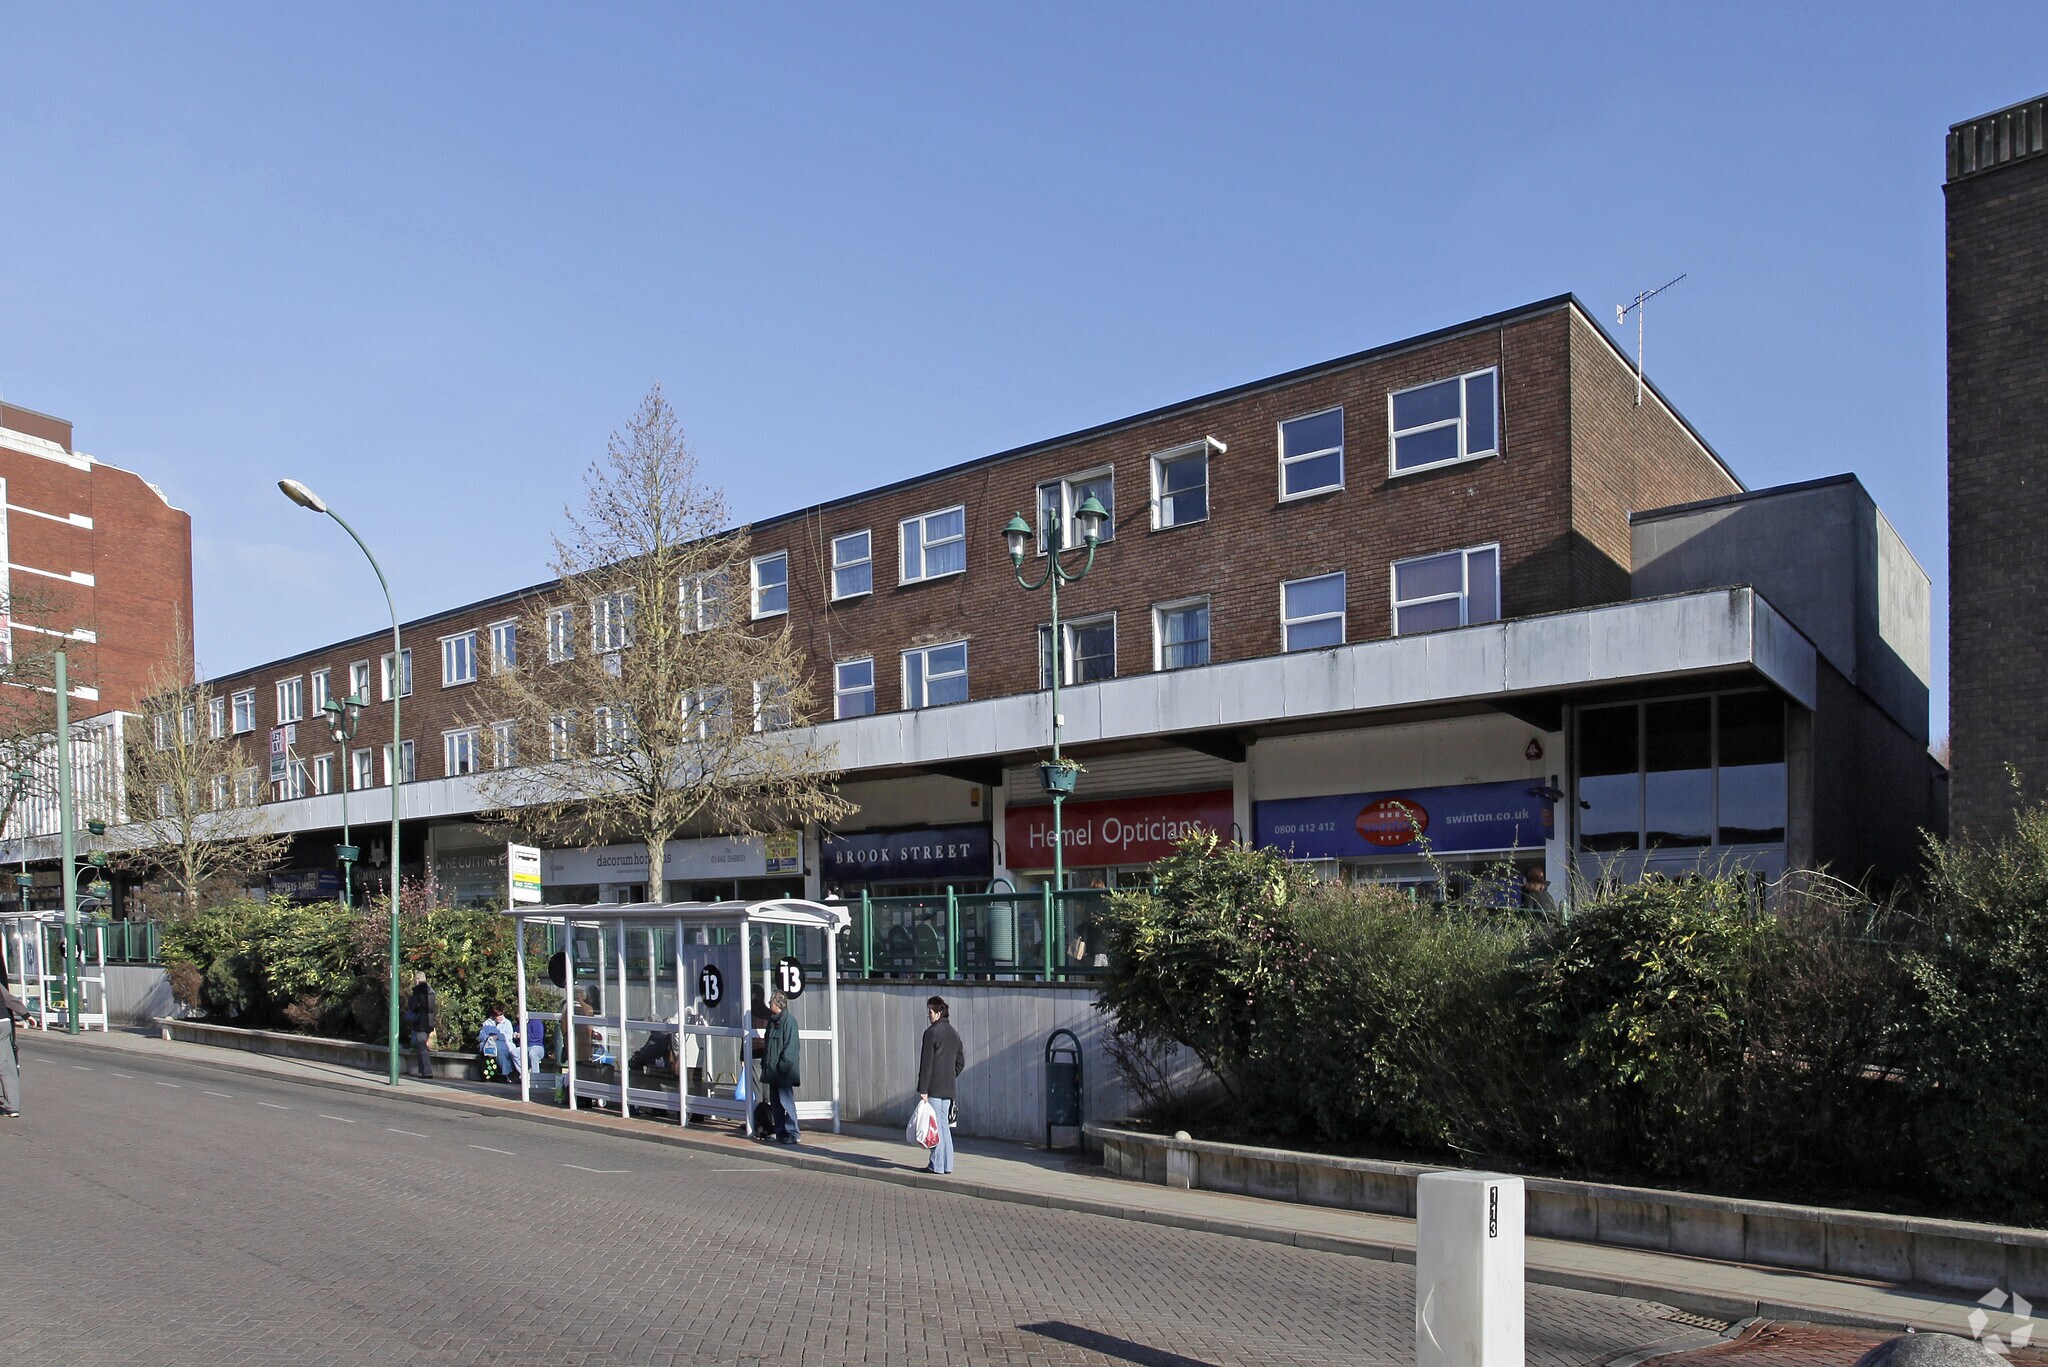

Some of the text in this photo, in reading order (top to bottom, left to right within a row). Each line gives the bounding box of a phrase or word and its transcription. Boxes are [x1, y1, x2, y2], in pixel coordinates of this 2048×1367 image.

[273, 742, 281, 751] BY
[1445, 808, 1530, 825] swinton.co.uk
[1029, 815, 1204, 852] Hemel Opticians
[1274, 821, 1336, 835] 0800 412 412
[1362, 819, 1417, 834] swinto
[835, 842, 971, 865] BROOK STREET
[441, 856, 457, 869] THE
[702, 974, 719, 1001] 13
[779, 966, 803, 993] 13
